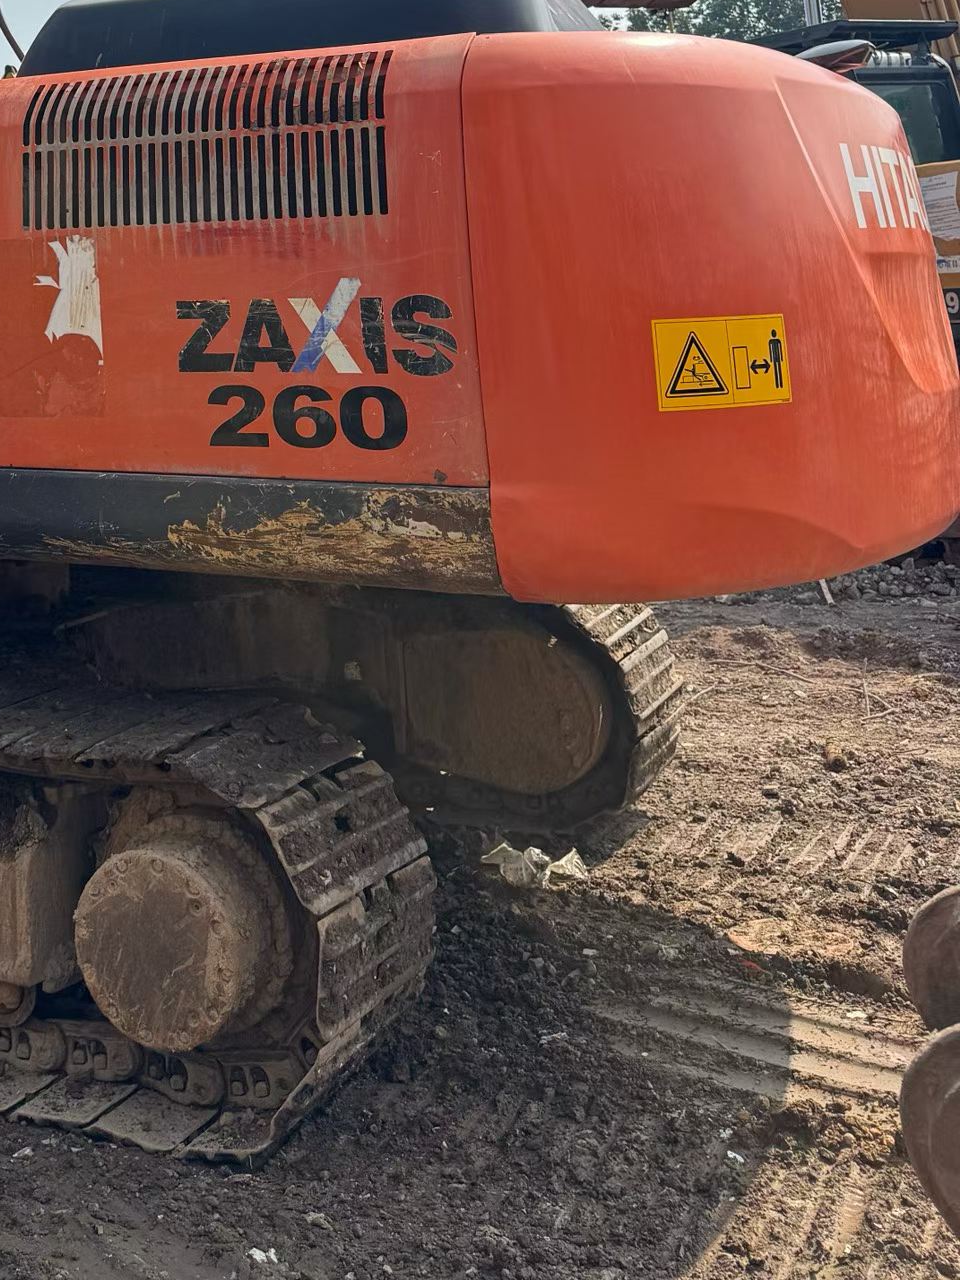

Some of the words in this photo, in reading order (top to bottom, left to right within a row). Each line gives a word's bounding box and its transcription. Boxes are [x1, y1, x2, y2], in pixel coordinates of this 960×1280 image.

[839, 143, 930, 231] HITA
[176, 277, 458, 376] ZAXIS
[207, 385, 408, 450] 260
